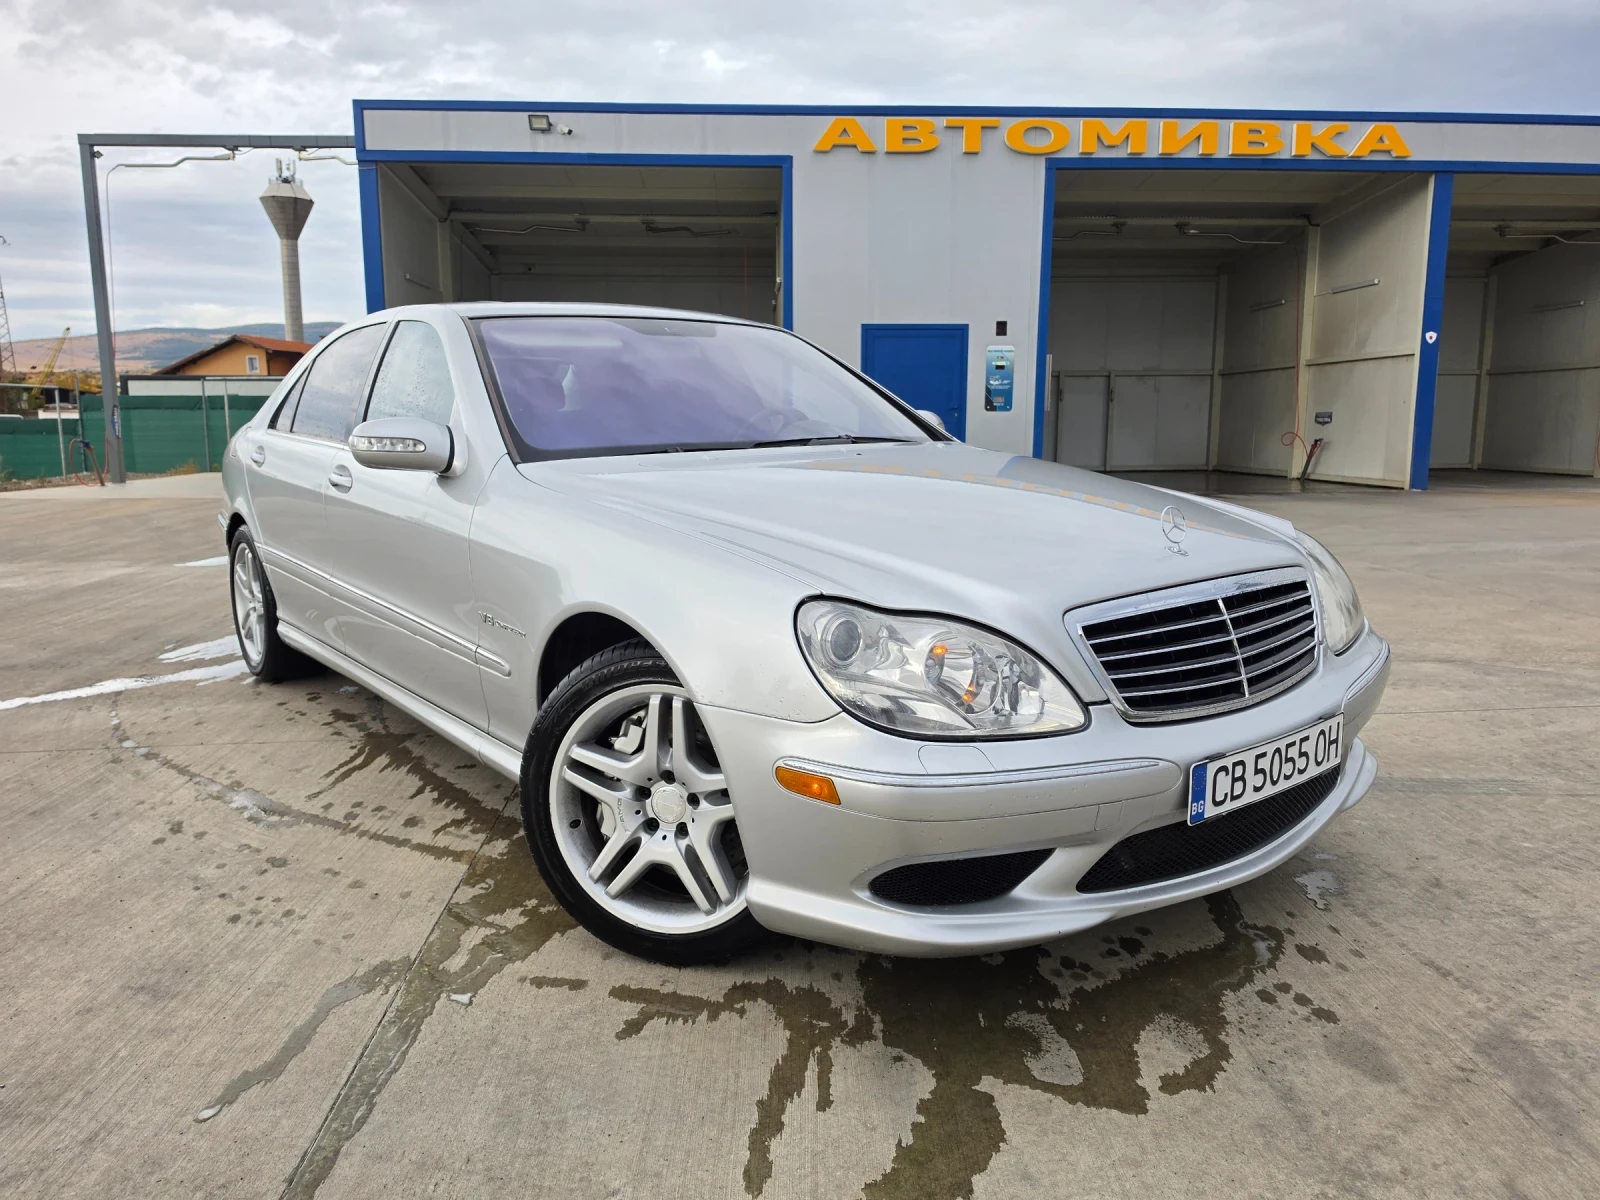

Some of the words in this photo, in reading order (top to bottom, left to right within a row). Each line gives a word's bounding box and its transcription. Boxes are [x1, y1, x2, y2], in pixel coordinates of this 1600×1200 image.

[813, 117, 1412, 158] АВТОМИВКА
[1211, 759, 1247, 808] CB
[1252, 734, 1310, 793] 5055
[1191, 800, 1204, 816] BG
